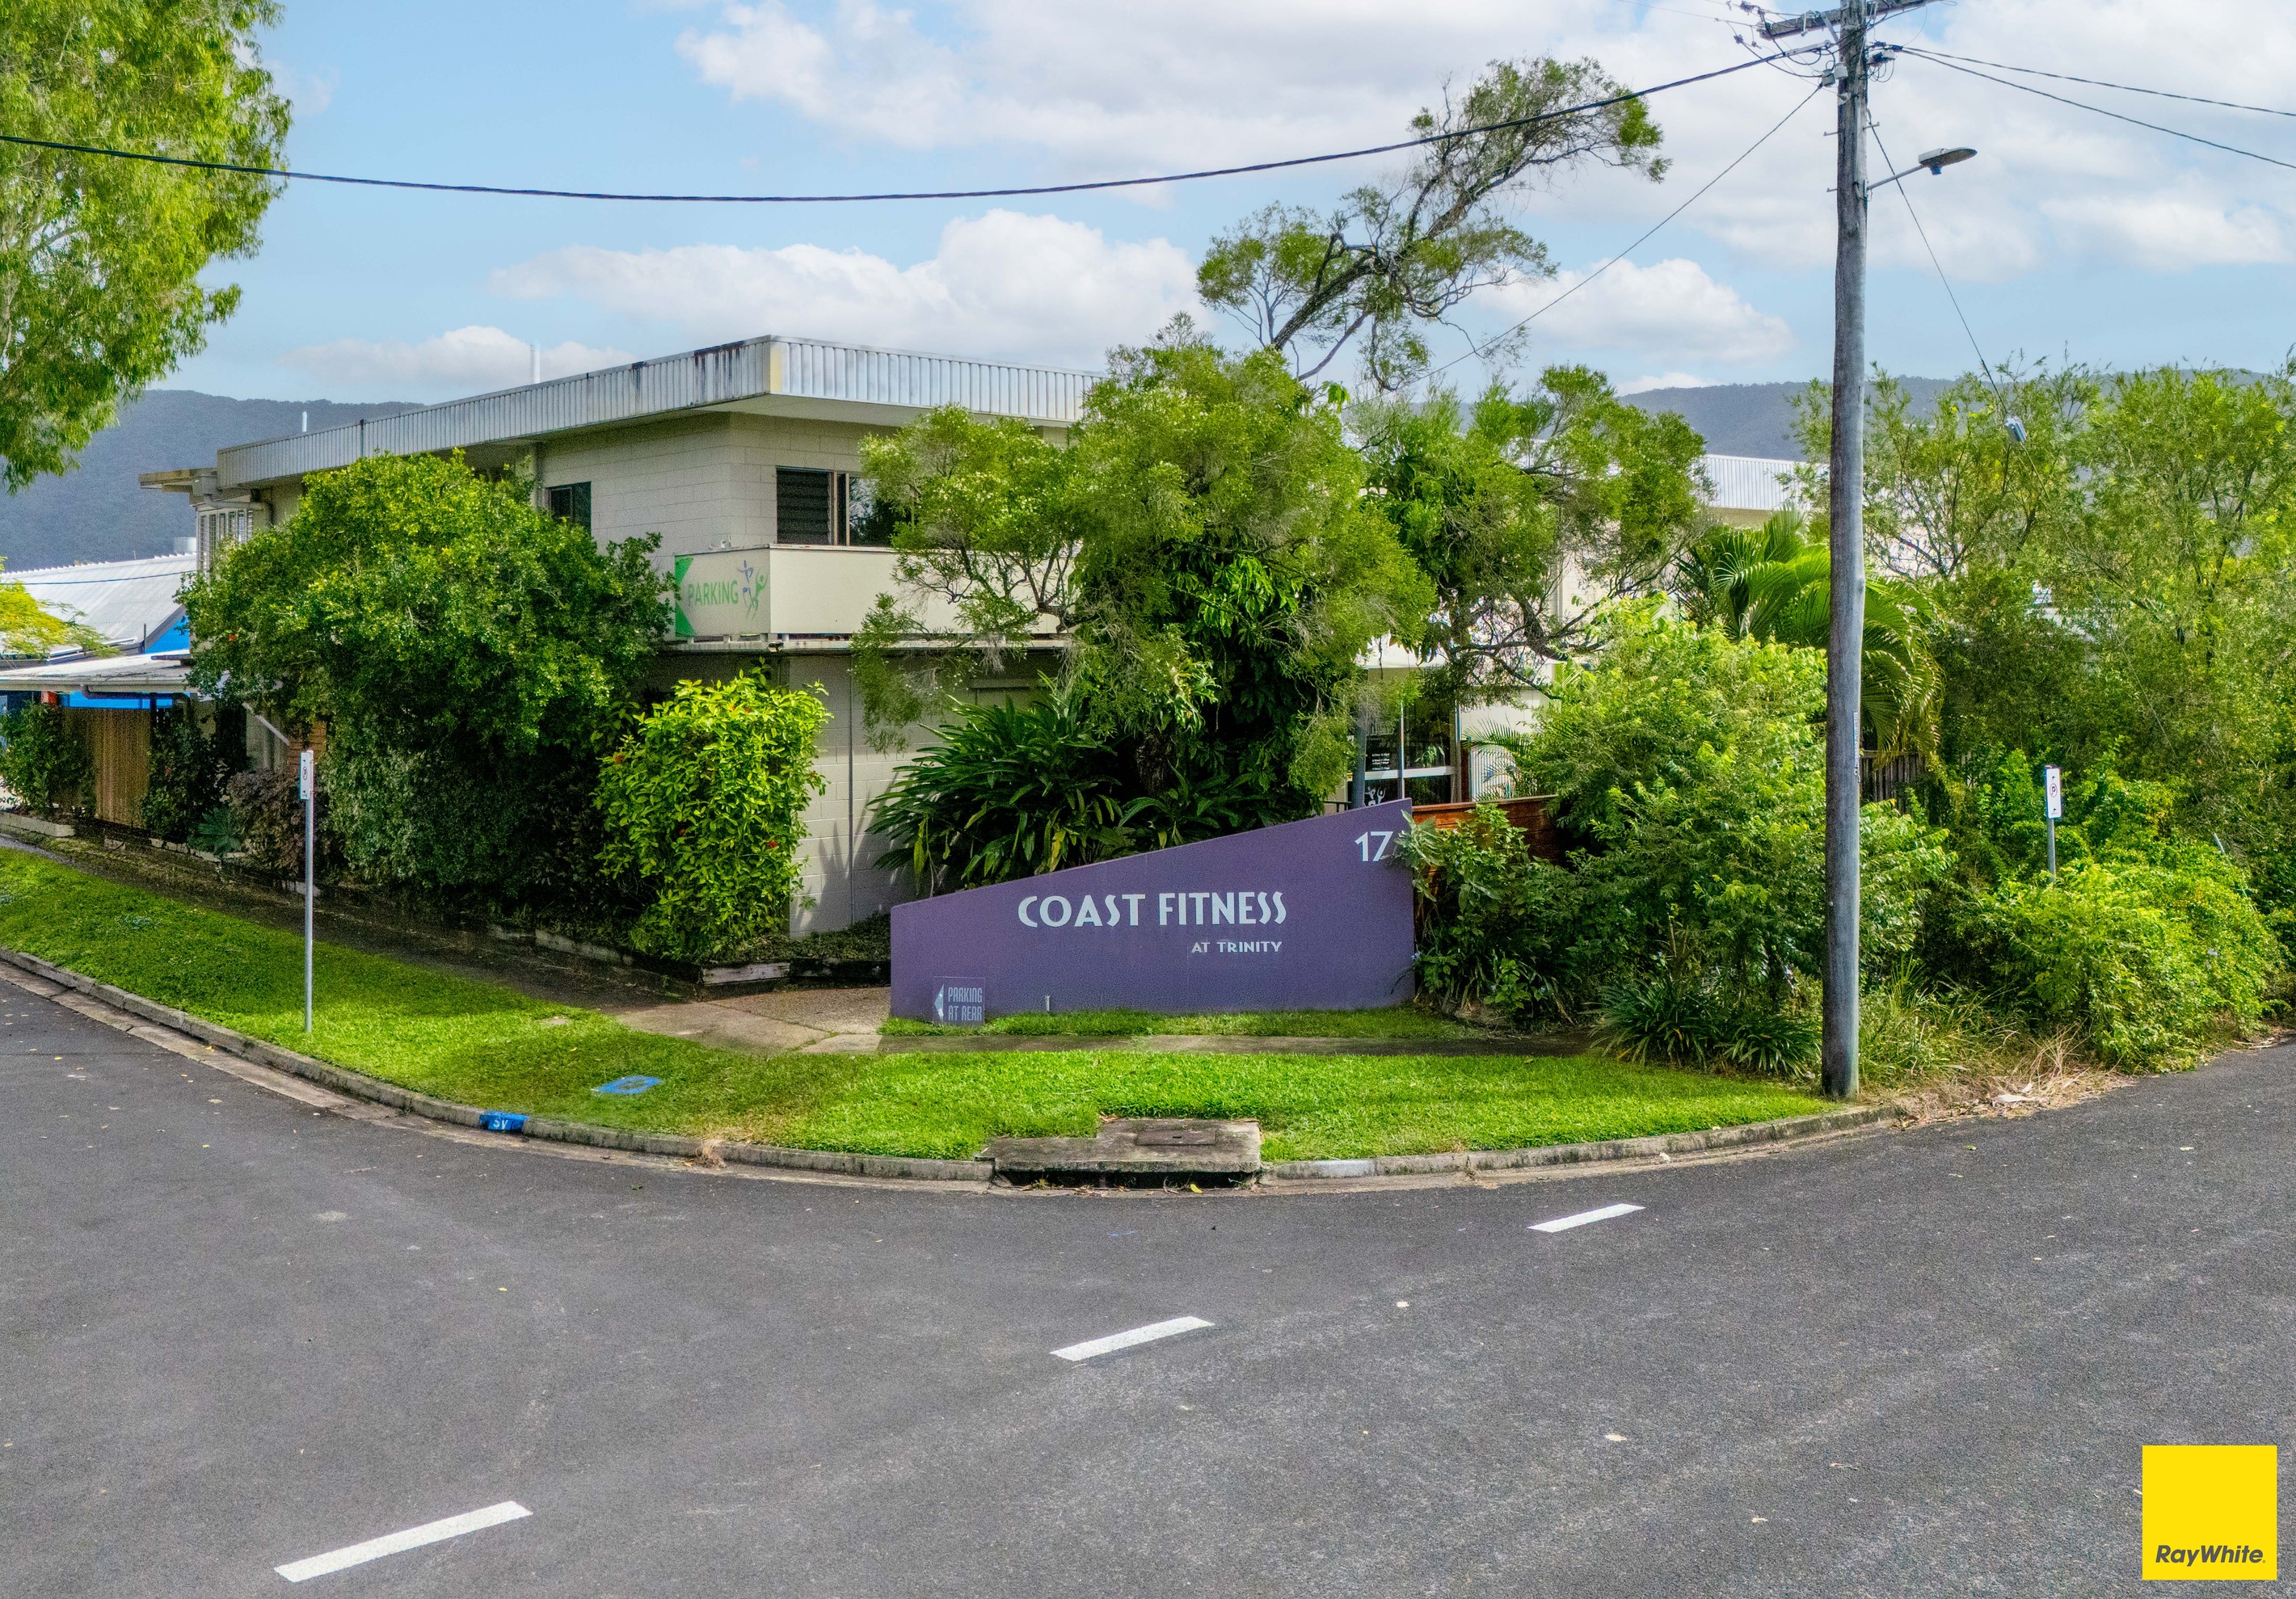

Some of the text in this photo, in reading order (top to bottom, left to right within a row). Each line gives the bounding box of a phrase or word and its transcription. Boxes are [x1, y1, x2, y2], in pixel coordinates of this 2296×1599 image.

[688, 580, 739, 607] PARKING
[1354, 831, 1394, 862] 17
[1017, 891, 1287, 928] COAST FITNESS
[1191, 941, 1283, 953] AT TRINITY
[948, 987, 983, 1003] PARKING
[948, 1005, 982, 1021] AT REAR
